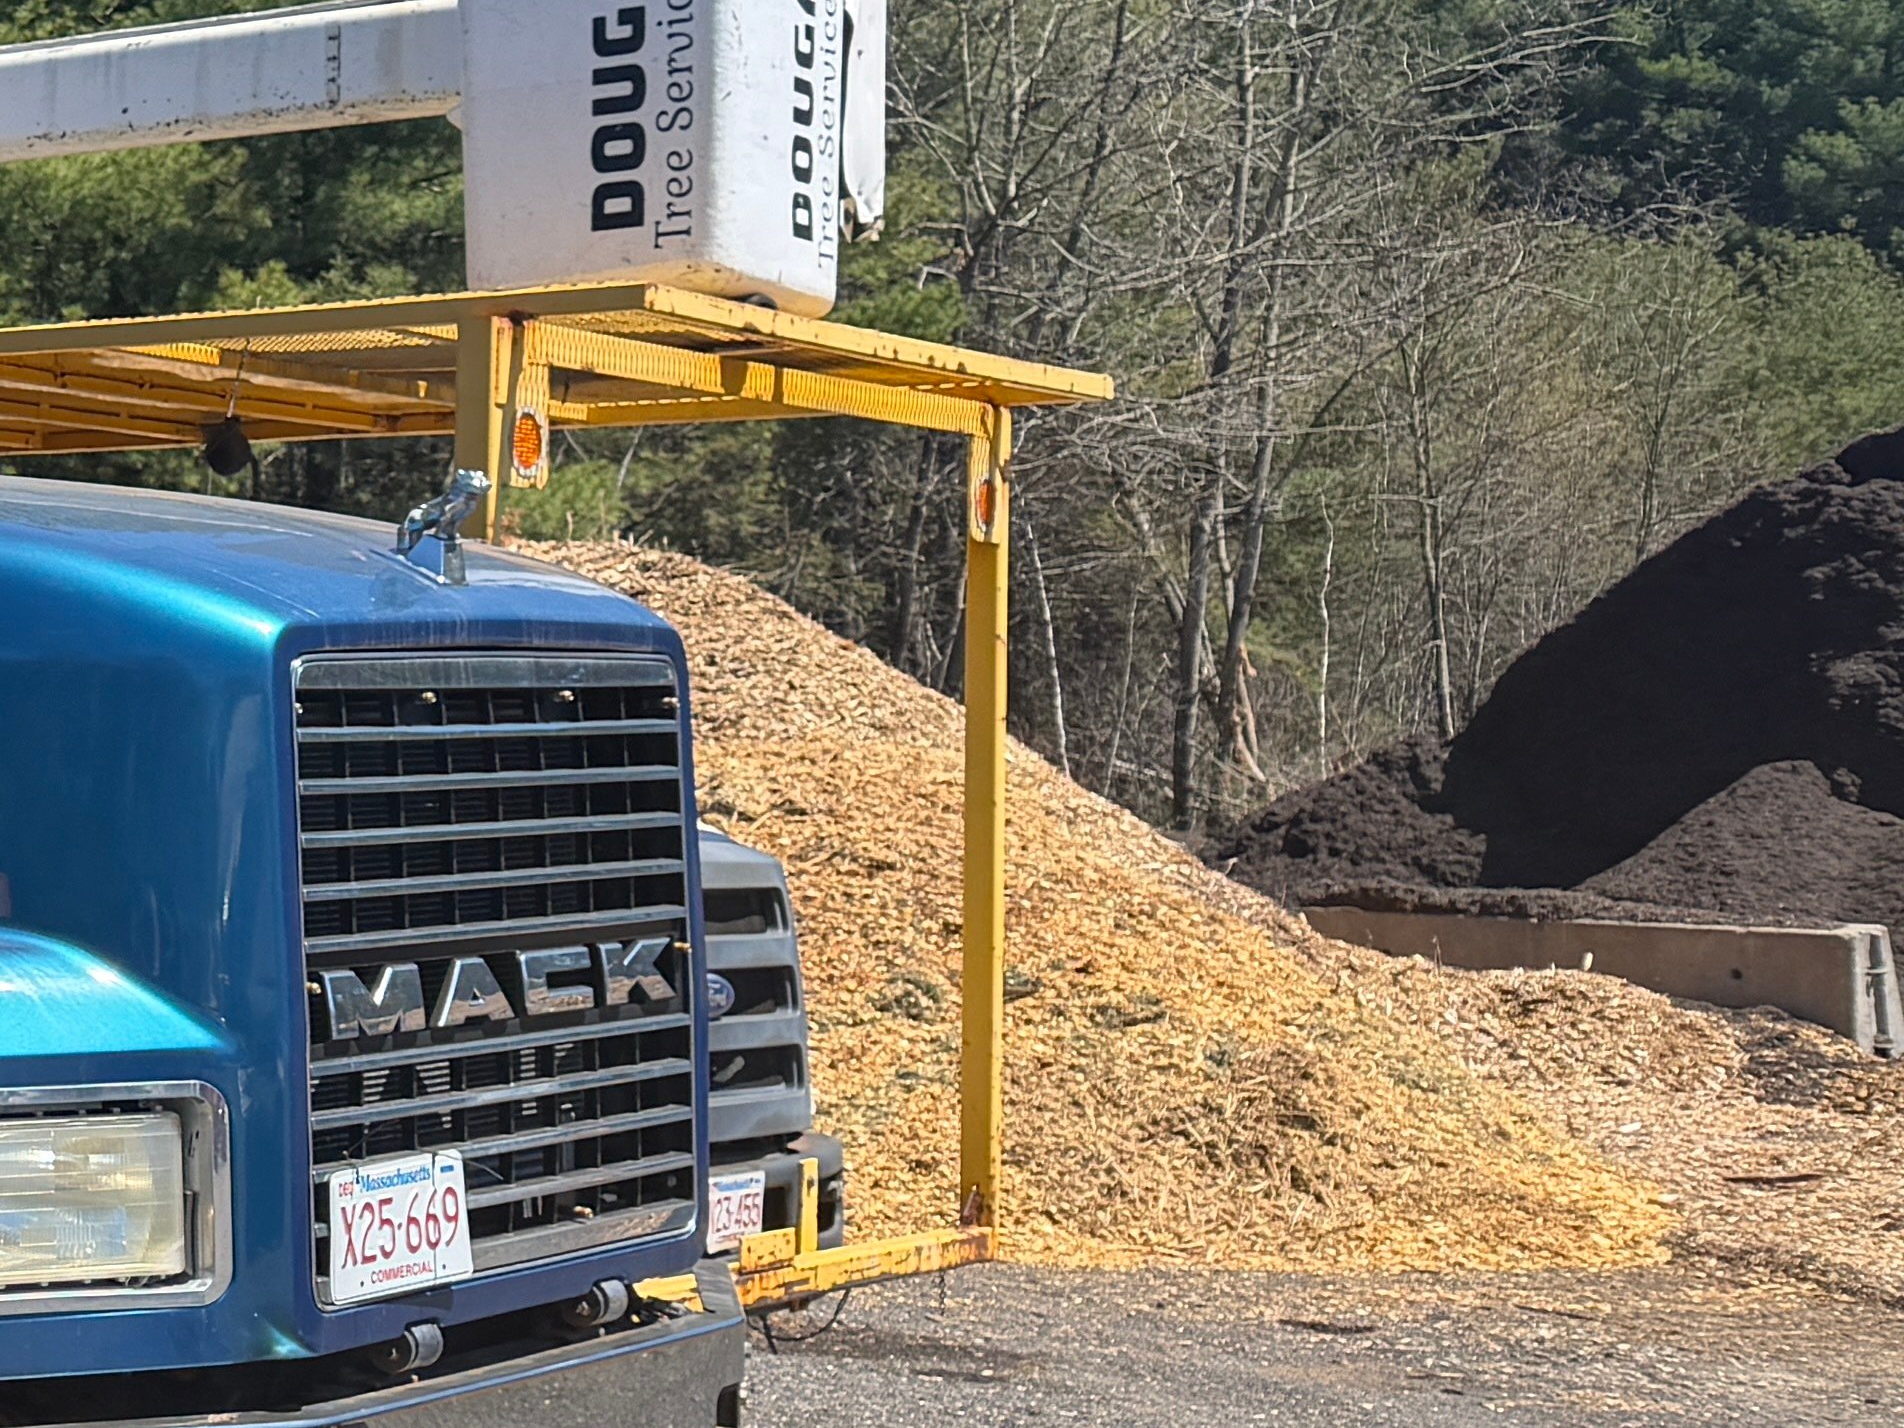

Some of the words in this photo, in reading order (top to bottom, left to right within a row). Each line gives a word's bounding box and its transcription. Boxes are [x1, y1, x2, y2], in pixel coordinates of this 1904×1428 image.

[654, 150, 693, 249] Tree
[818, 169, 836, 269] Tree
[319, 936, 676, 1040] MACK
[360, 1165, 431, 1193] Massachusetts
[370, 1261, 433, 1284] COMMERCIAL
